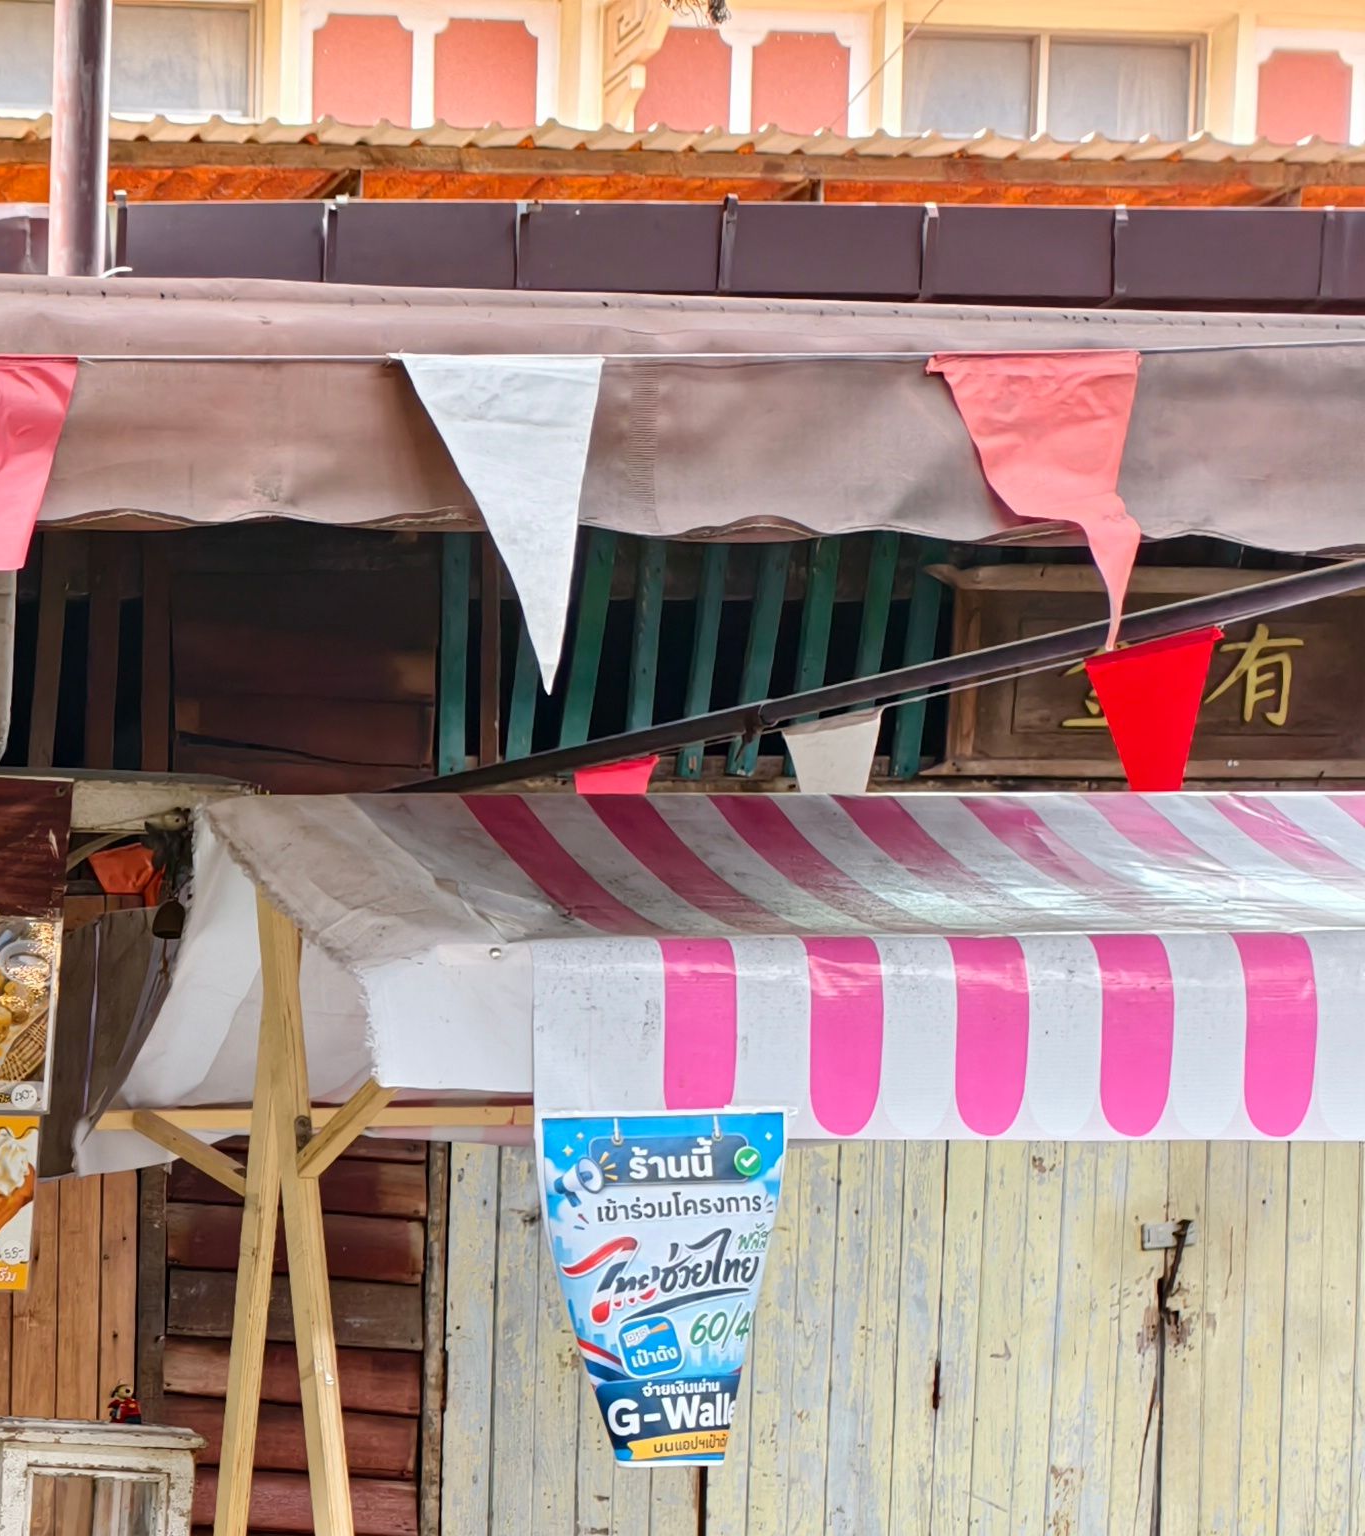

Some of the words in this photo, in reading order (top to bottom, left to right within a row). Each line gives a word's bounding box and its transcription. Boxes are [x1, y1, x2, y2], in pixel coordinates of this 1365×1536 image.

[629, 1137, 714, 1180] ร้านนี้
[597, 1192, 763, 1223] เข้าร่วมโครงการ
[689, 1301, 751, 1350] 60/4
[642, 1378, 720, 1397] จ่ายเงินผ่าน
[607, 1393, 737, 1436] G-Walle
